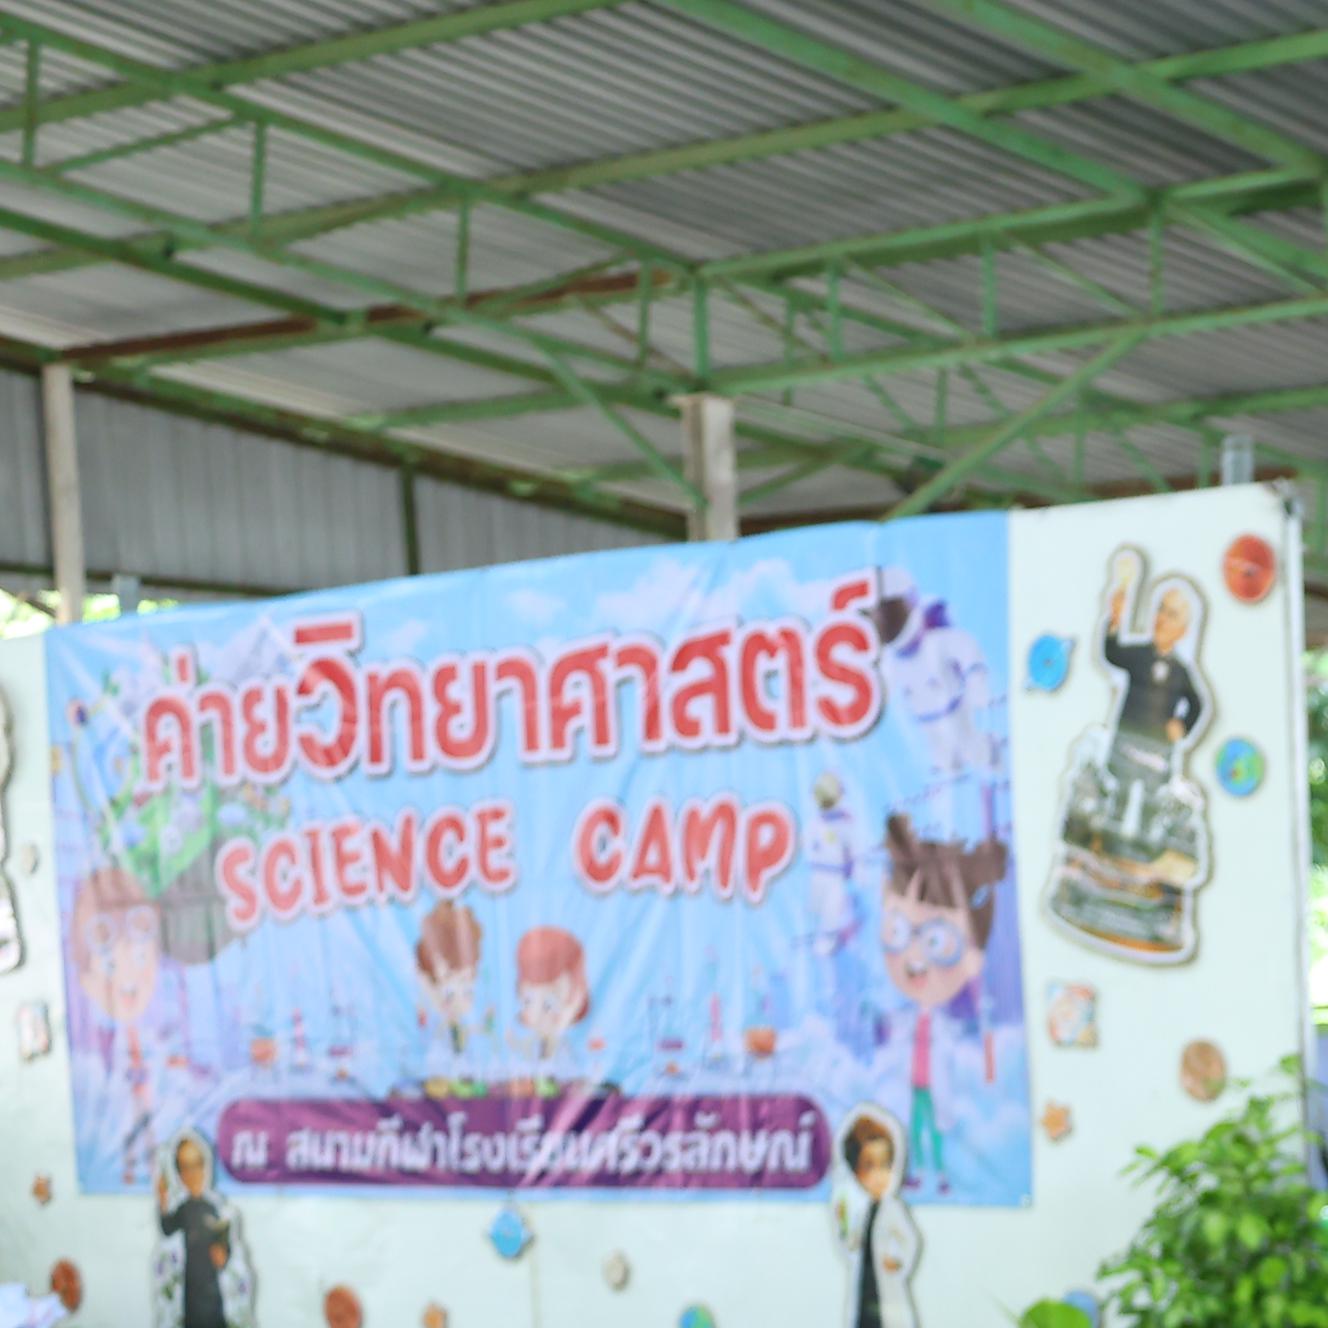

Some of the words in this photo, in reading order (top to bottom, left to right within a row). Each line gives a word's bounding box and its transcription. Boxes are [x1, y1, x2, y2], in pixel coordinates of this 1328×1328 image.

[141, 573, 880, 787] ค่ายวิทยาศาสตร์
[219, 800, 516, 924] SCIENCE
[574, 796, 794, 897] CAMP
[231, 1128, 267, 1171] ณ
